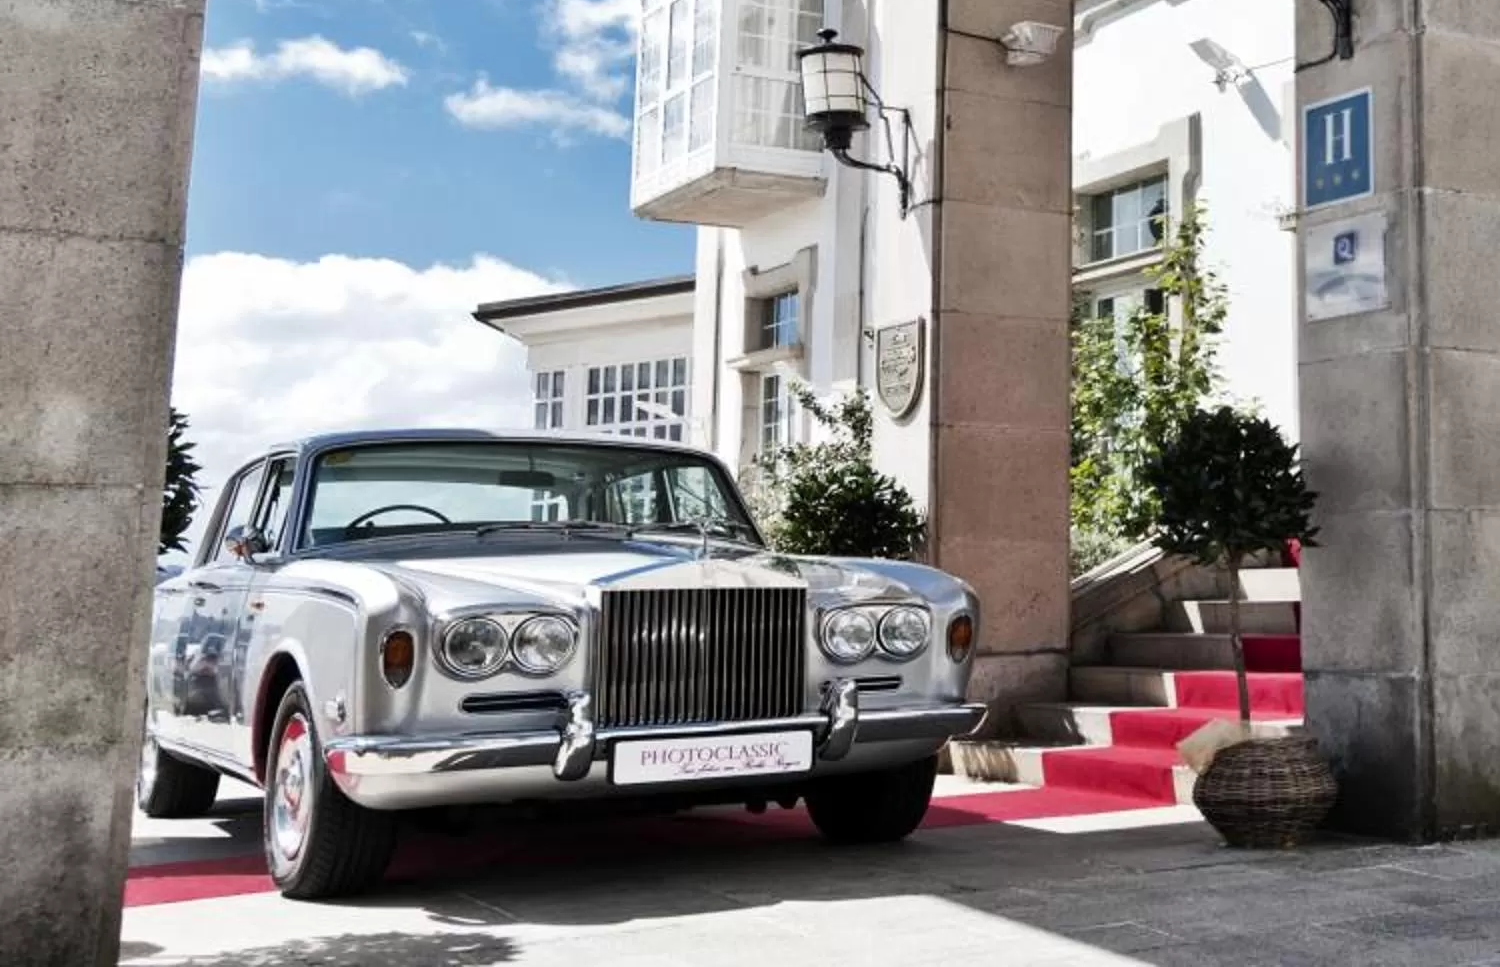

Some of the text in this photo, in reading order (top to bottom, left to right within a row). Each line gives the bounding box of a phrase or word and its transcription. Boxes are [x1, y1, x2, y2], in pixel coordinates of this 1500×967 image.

[1323, 108, 1353, 166] H
[1338, 237, 1353, 259] Q
[640, 741, 789, 766] PHOTOCLASSIC
